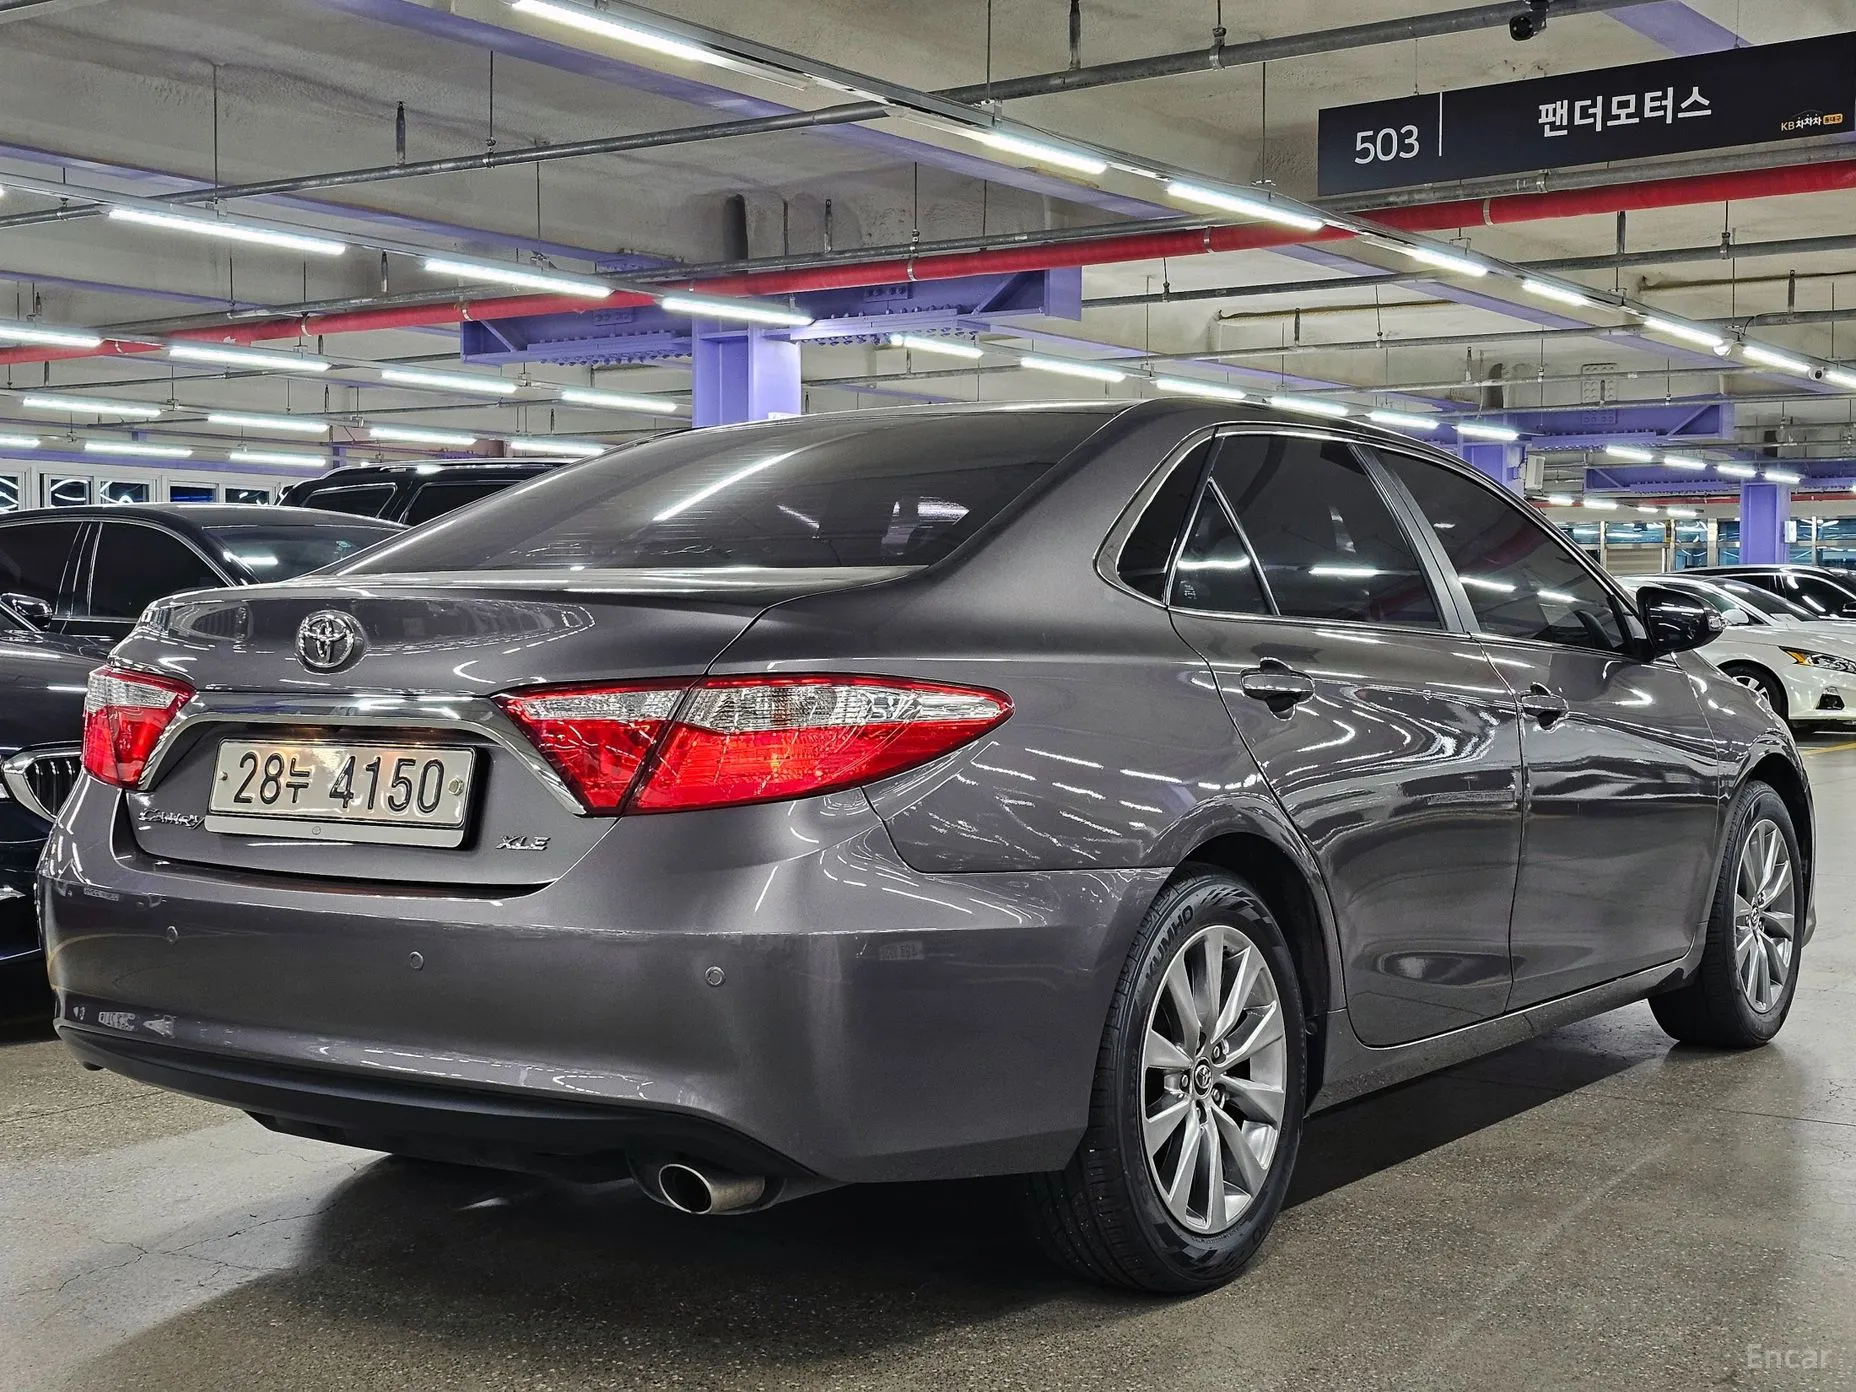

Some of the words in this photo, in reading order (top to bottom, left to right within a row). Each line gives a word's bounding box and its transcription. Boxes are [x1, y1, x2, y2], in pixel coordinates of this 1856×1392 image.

[1538, 86, 1712, 138] 팬더모터스
[1355, 124, 1420, 165] 503
[232, 751, 311, 805] 28누
[328, 755, 446, 813] 4150
[496, 835, 551, 850] XLE
[1145, 904, 1194, 981] KUMHO
